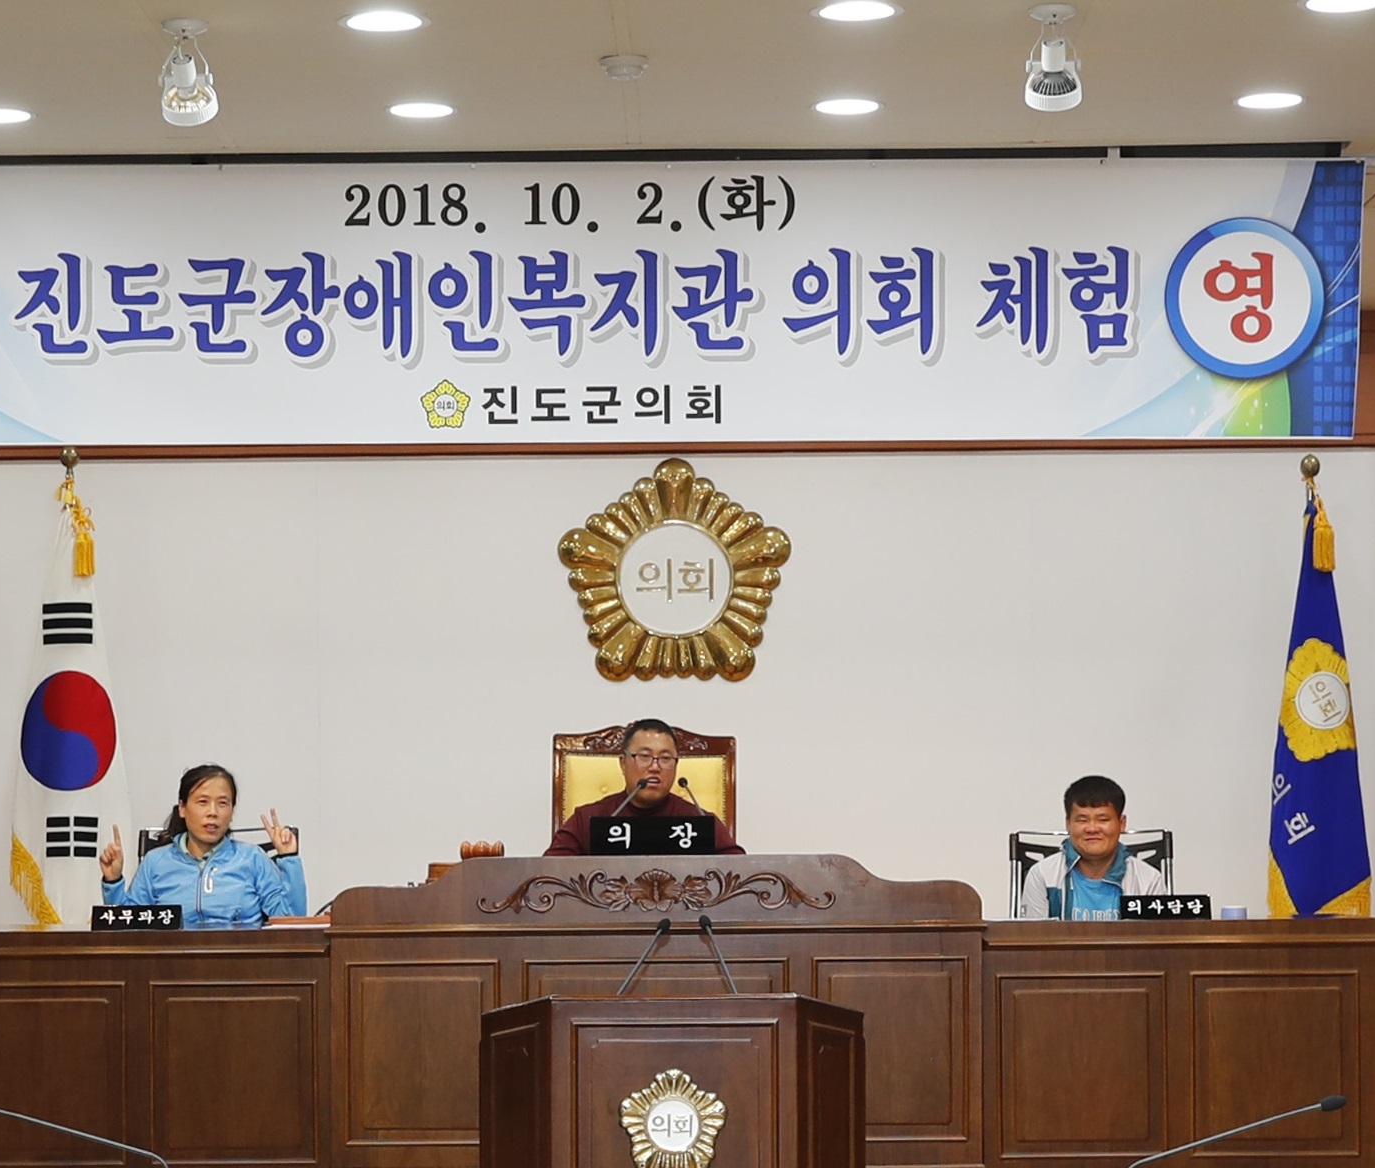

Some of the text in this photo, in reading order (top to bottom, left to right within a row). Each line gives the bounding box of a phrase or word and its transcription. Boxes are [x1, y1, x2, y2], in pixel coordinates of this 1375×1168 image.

[344, 182, 487, 234] 2018.
[524, 182, 599, 234] 10.
[16, 245, 1130, 359] 진도군장애인복지관 의회 체험
[1203, 251, 1275, 345] 영
[481, 384, 722, 425] 진도군의회
[635, 558, 715, 603] 의회
[99, 909, 175, 925] 사무과장
[1127, 898, 1204, 915] 의사담당
[650, 1113, 694, 1138] 의회
